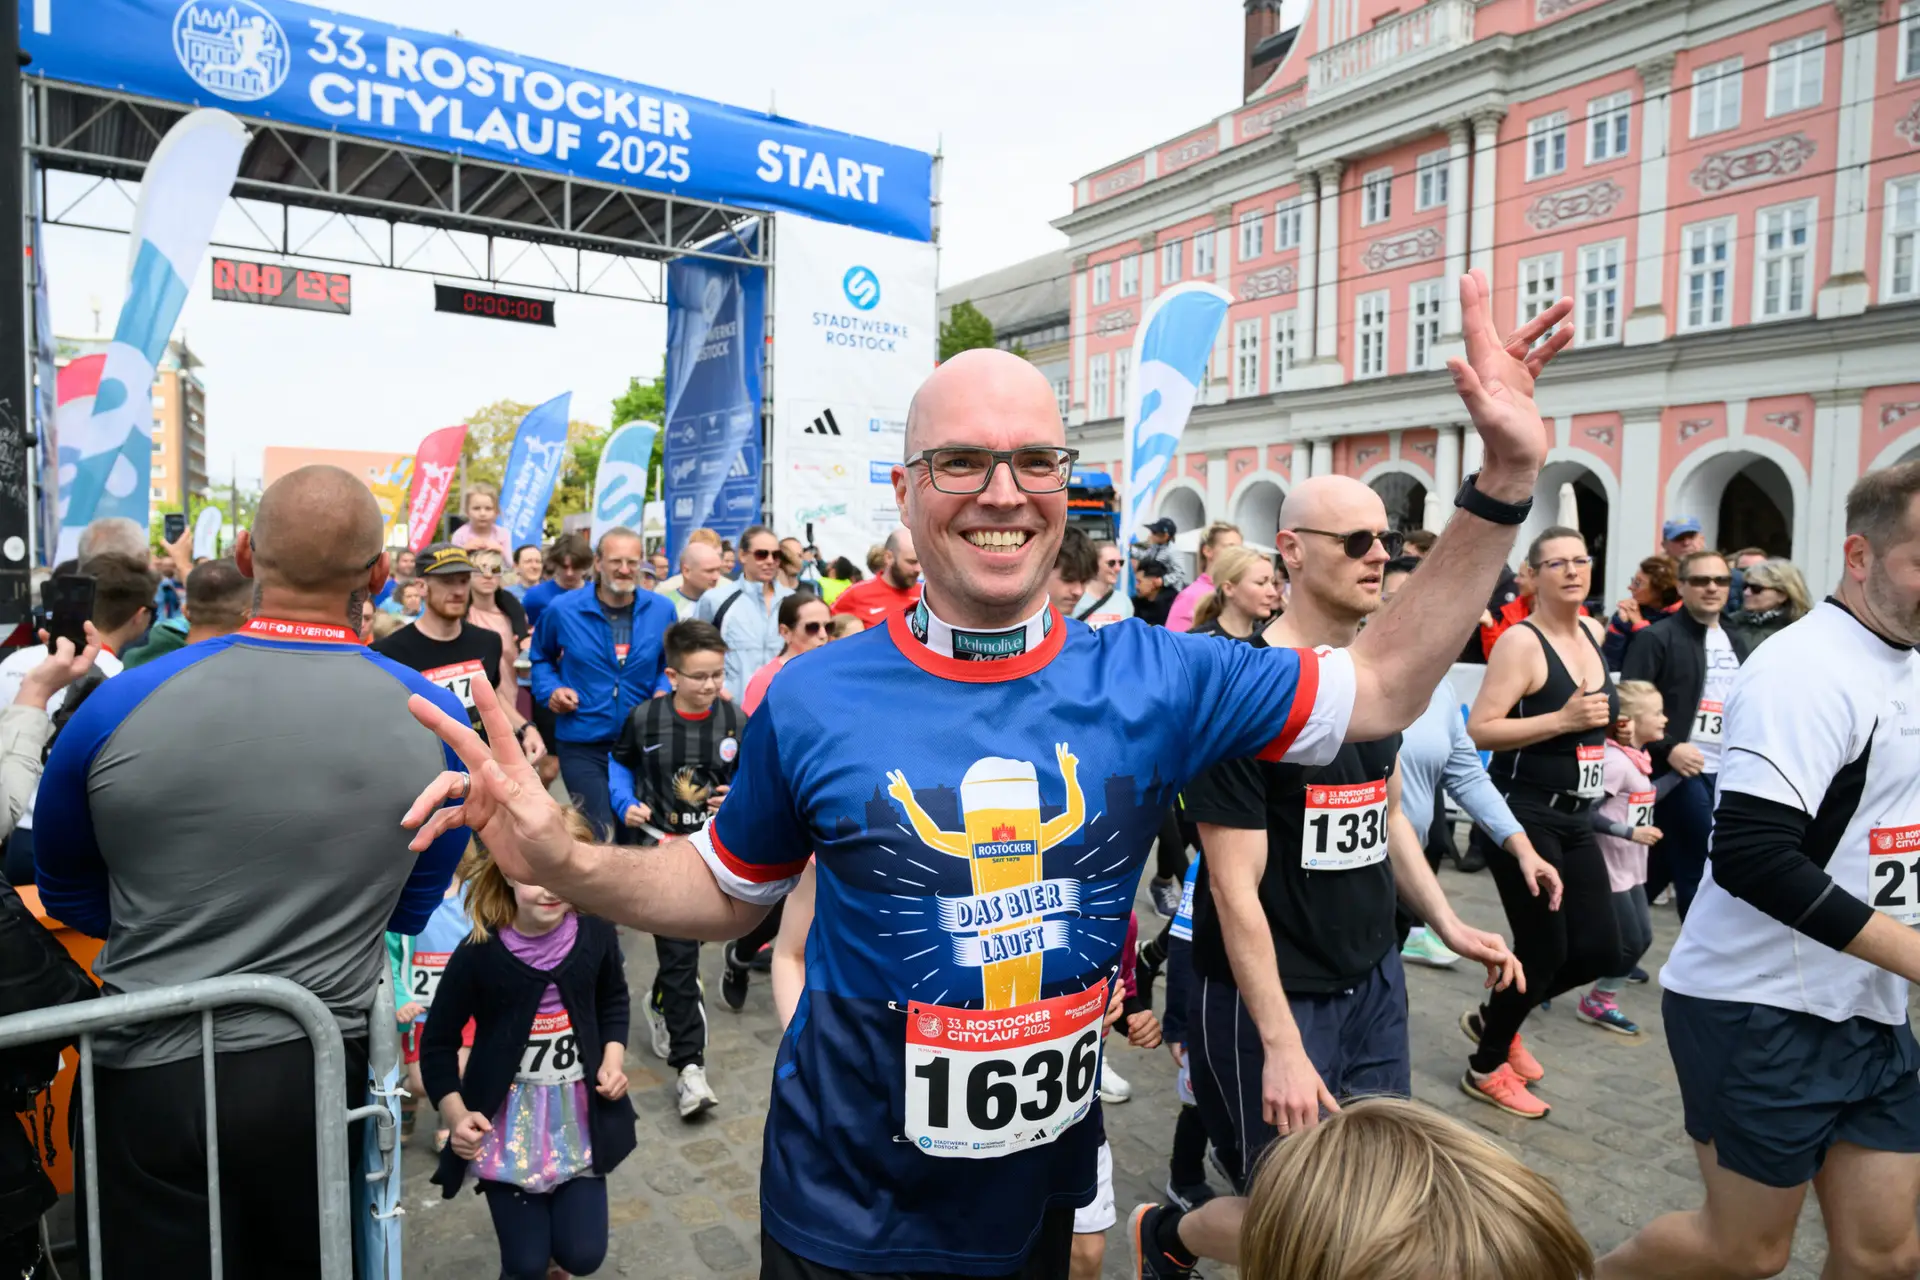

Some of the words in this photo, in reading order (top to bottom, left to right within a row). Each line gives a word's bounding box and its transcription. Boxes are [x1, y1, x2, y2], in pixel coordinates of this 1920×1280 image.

[307, 18, 377, 74] 33.
[386, 36, 693, 140] ROSTOCKER
[308, 72, 582, 161] CITYLAUF
[596, 130, 692, 184] 2025
[757, 139, 885, 204] START
[463, 292, 543, 322] 0:00:00
[811, 311, 910, 339] STADTWERKE
[826, 330, 898, 353] ROSTOCK
[268, 622, 294, 634] FOR
[295, 625, 346, 639] EVERYONE
[957, 634, 1022, 653] Palmolive
[1328, 796, 1363, 805] CITYLAUF
[978, 842, 1032, 856] ROSTOCKER
[956, 893, 1002, 928] DAS
[1004, 883, 1063, 919] BIER
[979, 925, 1046, 965] LÄUFT
[946, 1017, 965, 1031] 33.
[965, 1010, 1051, 1031] ROSTOCKER
[946, 1029, 1020, 1044] CITYLAUF
[1023, 1023, 1051, 1038] 2025
[914, 1029, 1098, 1131] 1636
[933, 1139, 968, 1147] STADTWERKE
